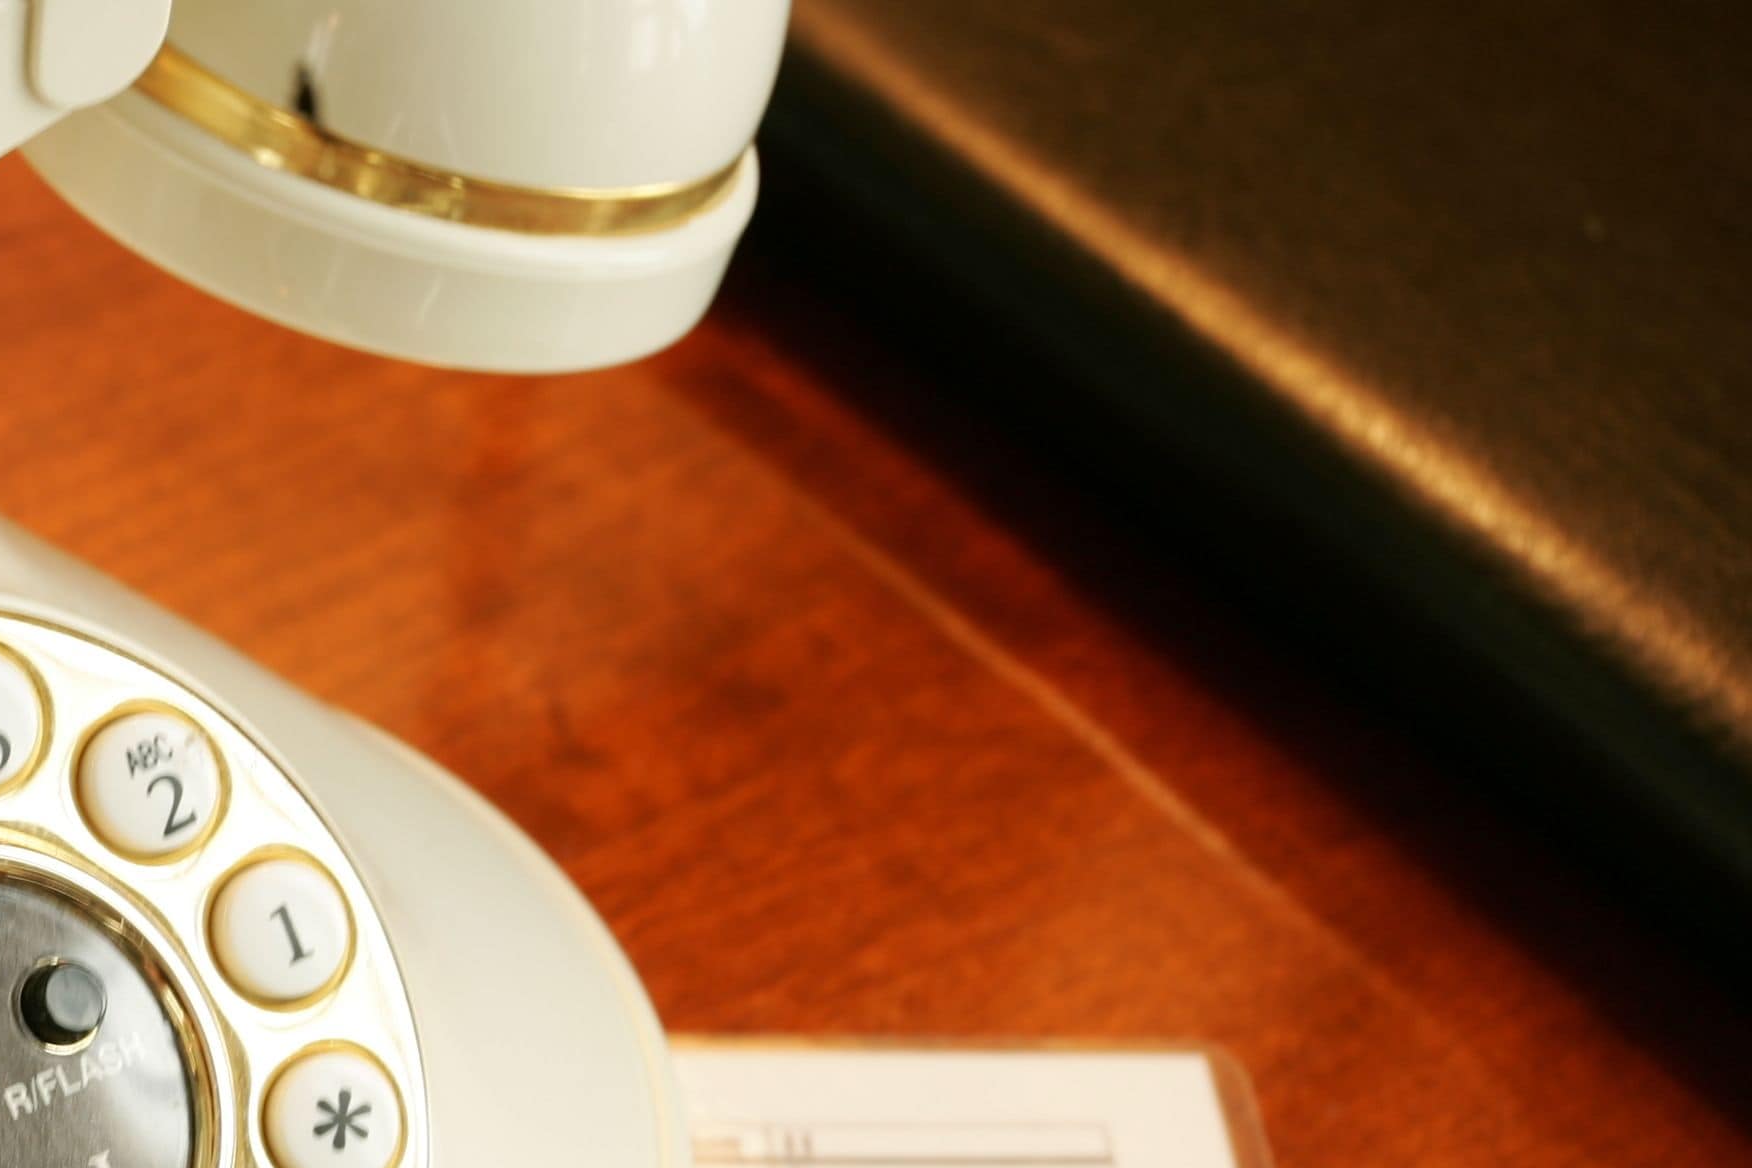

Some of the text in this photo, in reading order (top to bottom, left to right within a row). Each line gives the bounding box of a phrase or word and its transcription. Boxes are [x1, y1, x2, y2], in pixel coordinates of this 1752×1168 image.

[126, 733, 174, 779] ABC
[147, 773, 197, 838] 2
[267, 902, 315, 969] 1
[3, 1031, 146, 1121] R/FLASH
